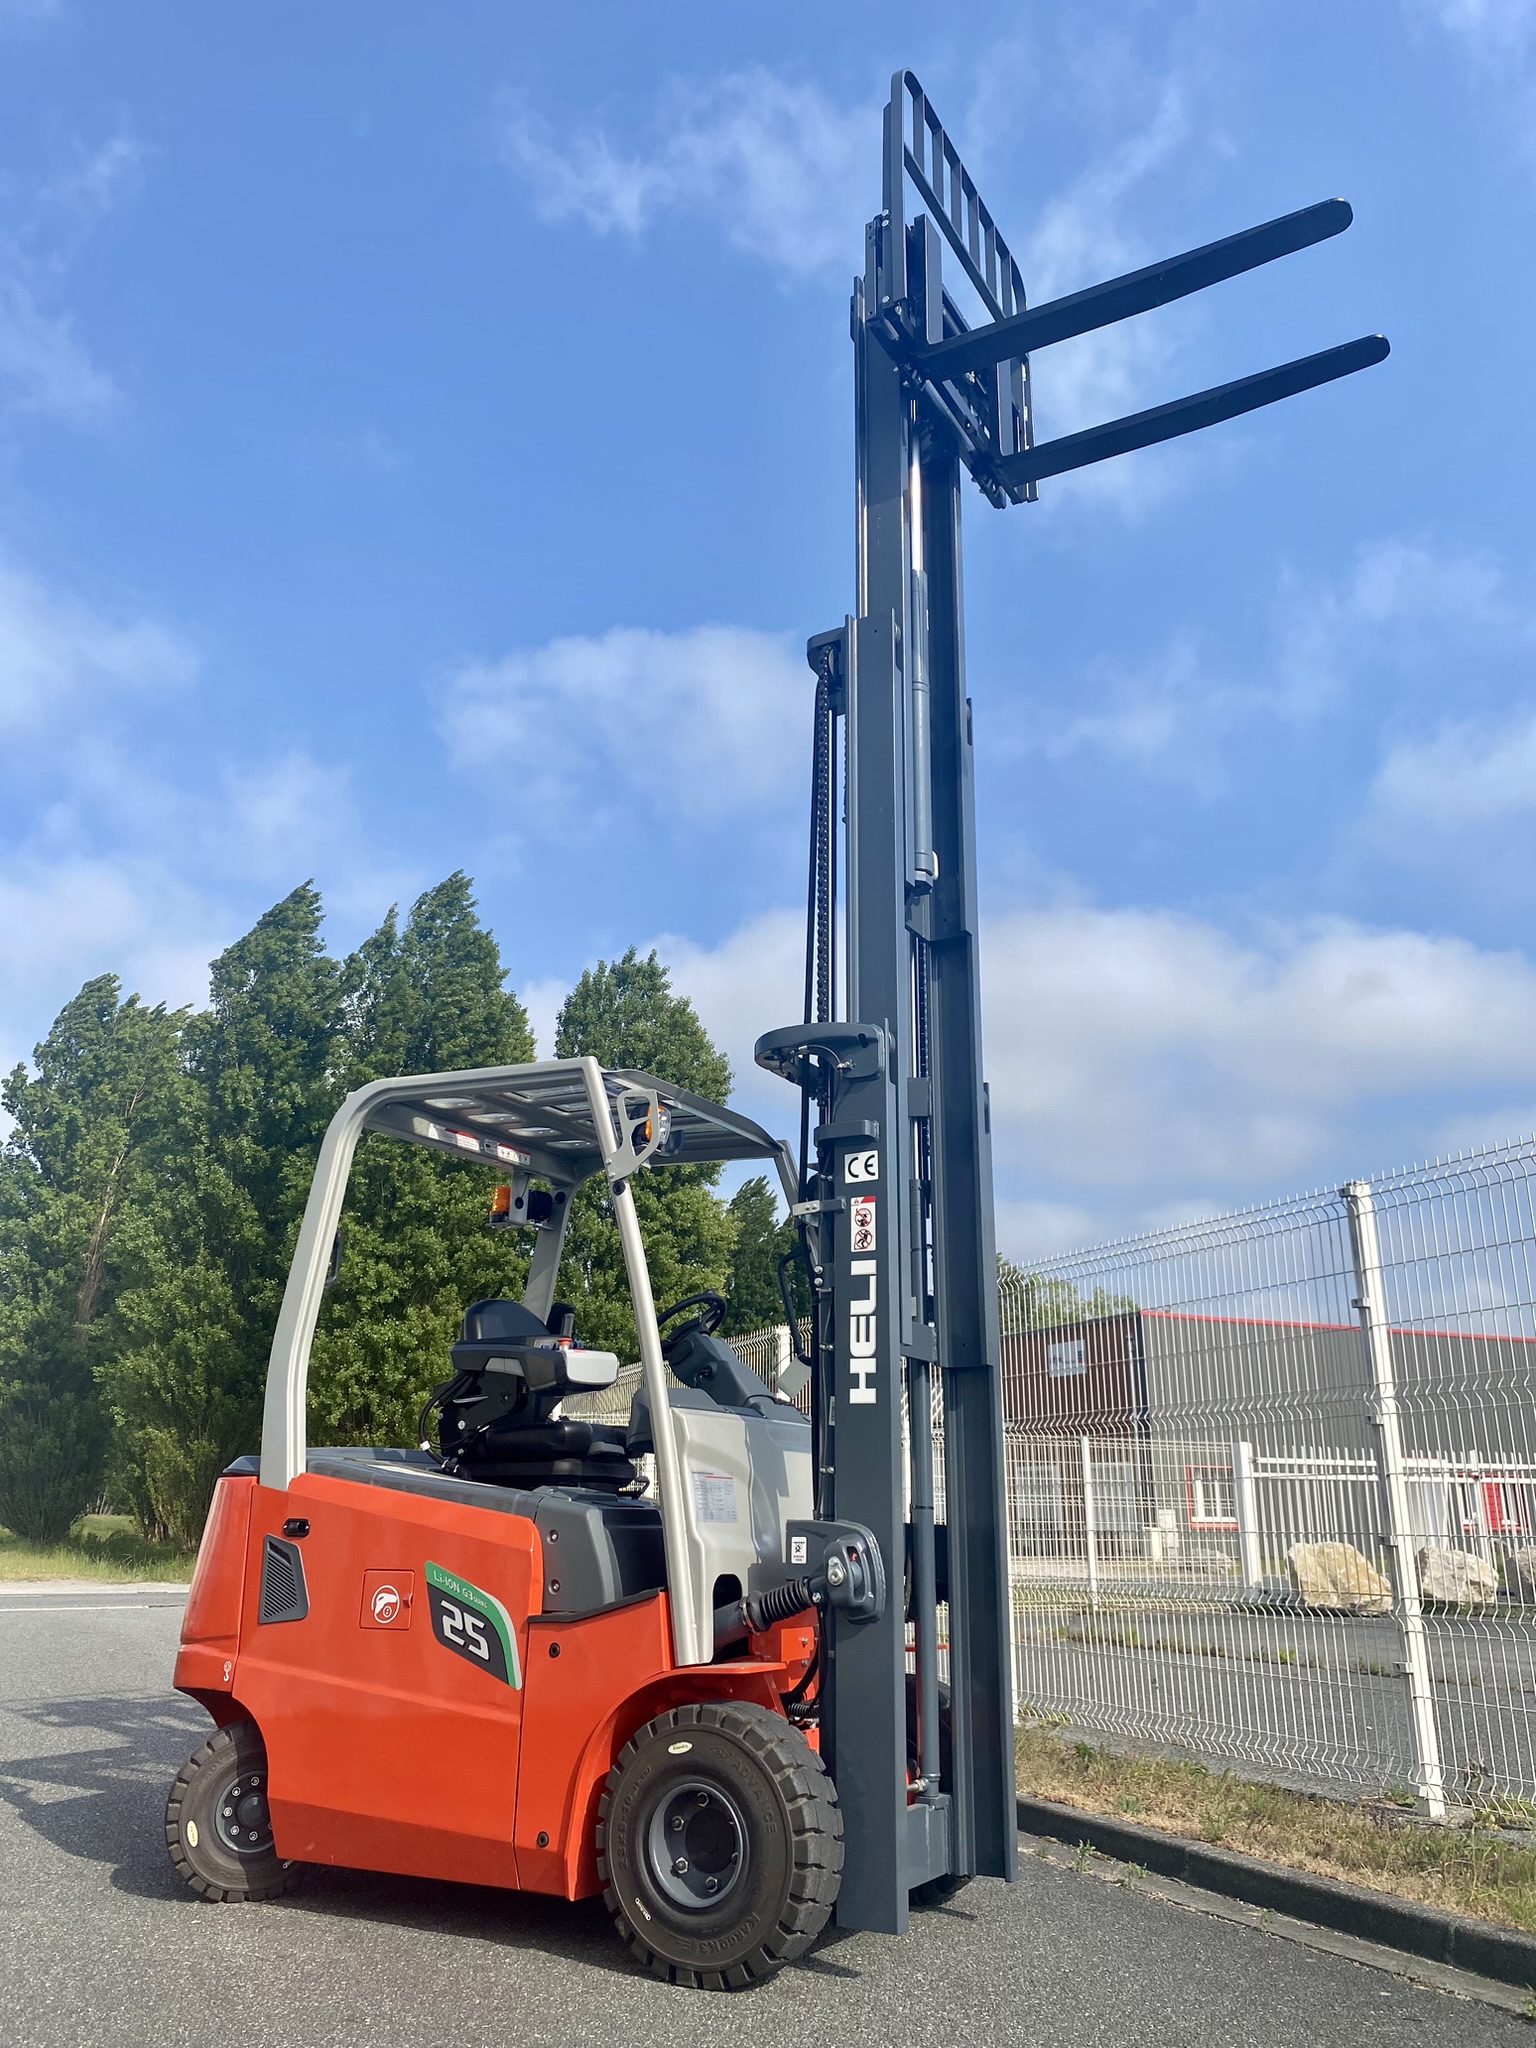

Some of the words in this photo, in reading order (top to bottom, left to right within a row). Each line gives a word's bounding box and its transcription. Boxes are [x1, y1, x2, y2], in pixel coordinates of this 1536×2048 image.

[848, 1154, 876, 1178] CE
[850, 1259, 877, 1404] HELI
[441, 1600, 489, 1660] 25
